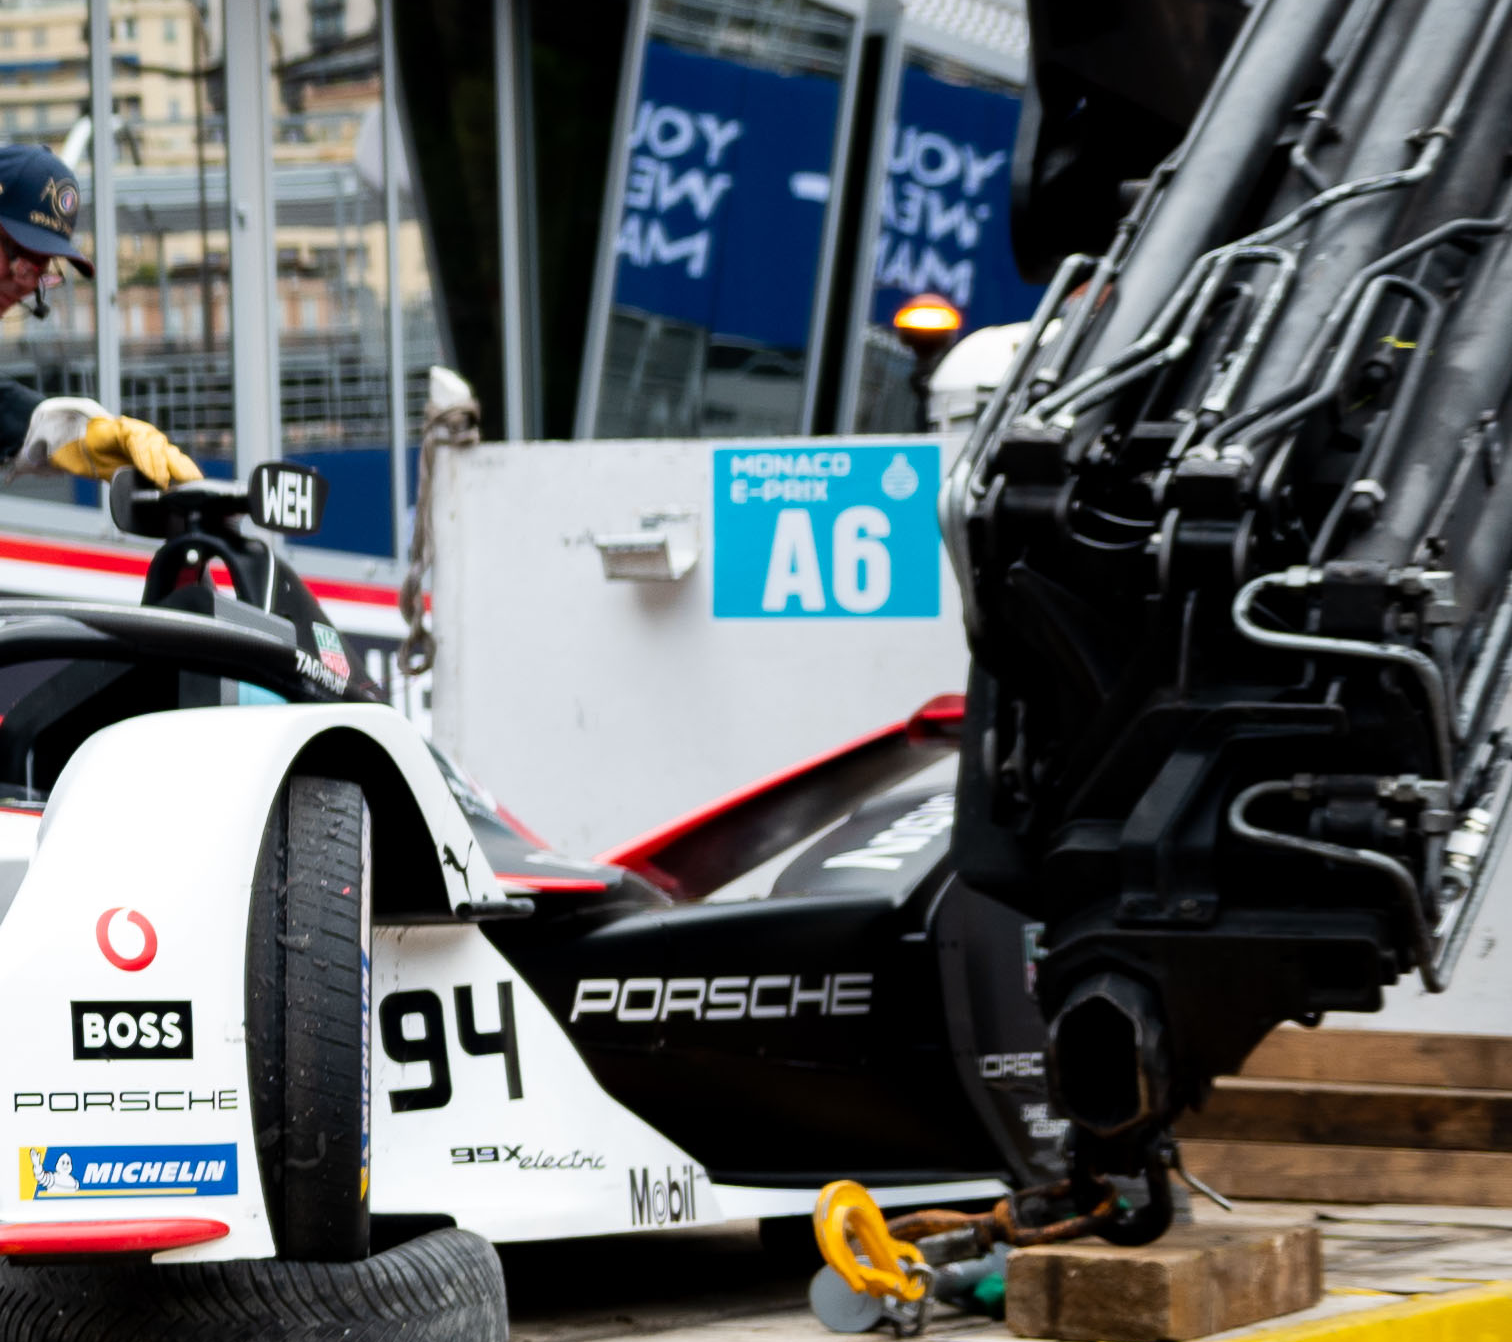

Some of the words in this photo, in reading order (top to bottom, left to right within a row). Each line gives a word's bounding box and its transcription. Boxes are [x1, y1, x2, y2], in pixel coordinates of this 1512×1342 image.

[730, 453, 851, 478] MONACO
[262, 469, 315, 530] WEH
[730, 479, 829, 504] E-PRIX
[762, 505, 892, 614] A6
[570, 972, 873, 1025] PORSCHE
[83, 1012, 183, 1049] BOSS
[378, 980, 524, 1114] 94
[14, 1090, 238, 1113] PORSCHE
[82, 1160, 226, 1185] MICHELIN
[629, 1165, 696, 1226] Mobil
